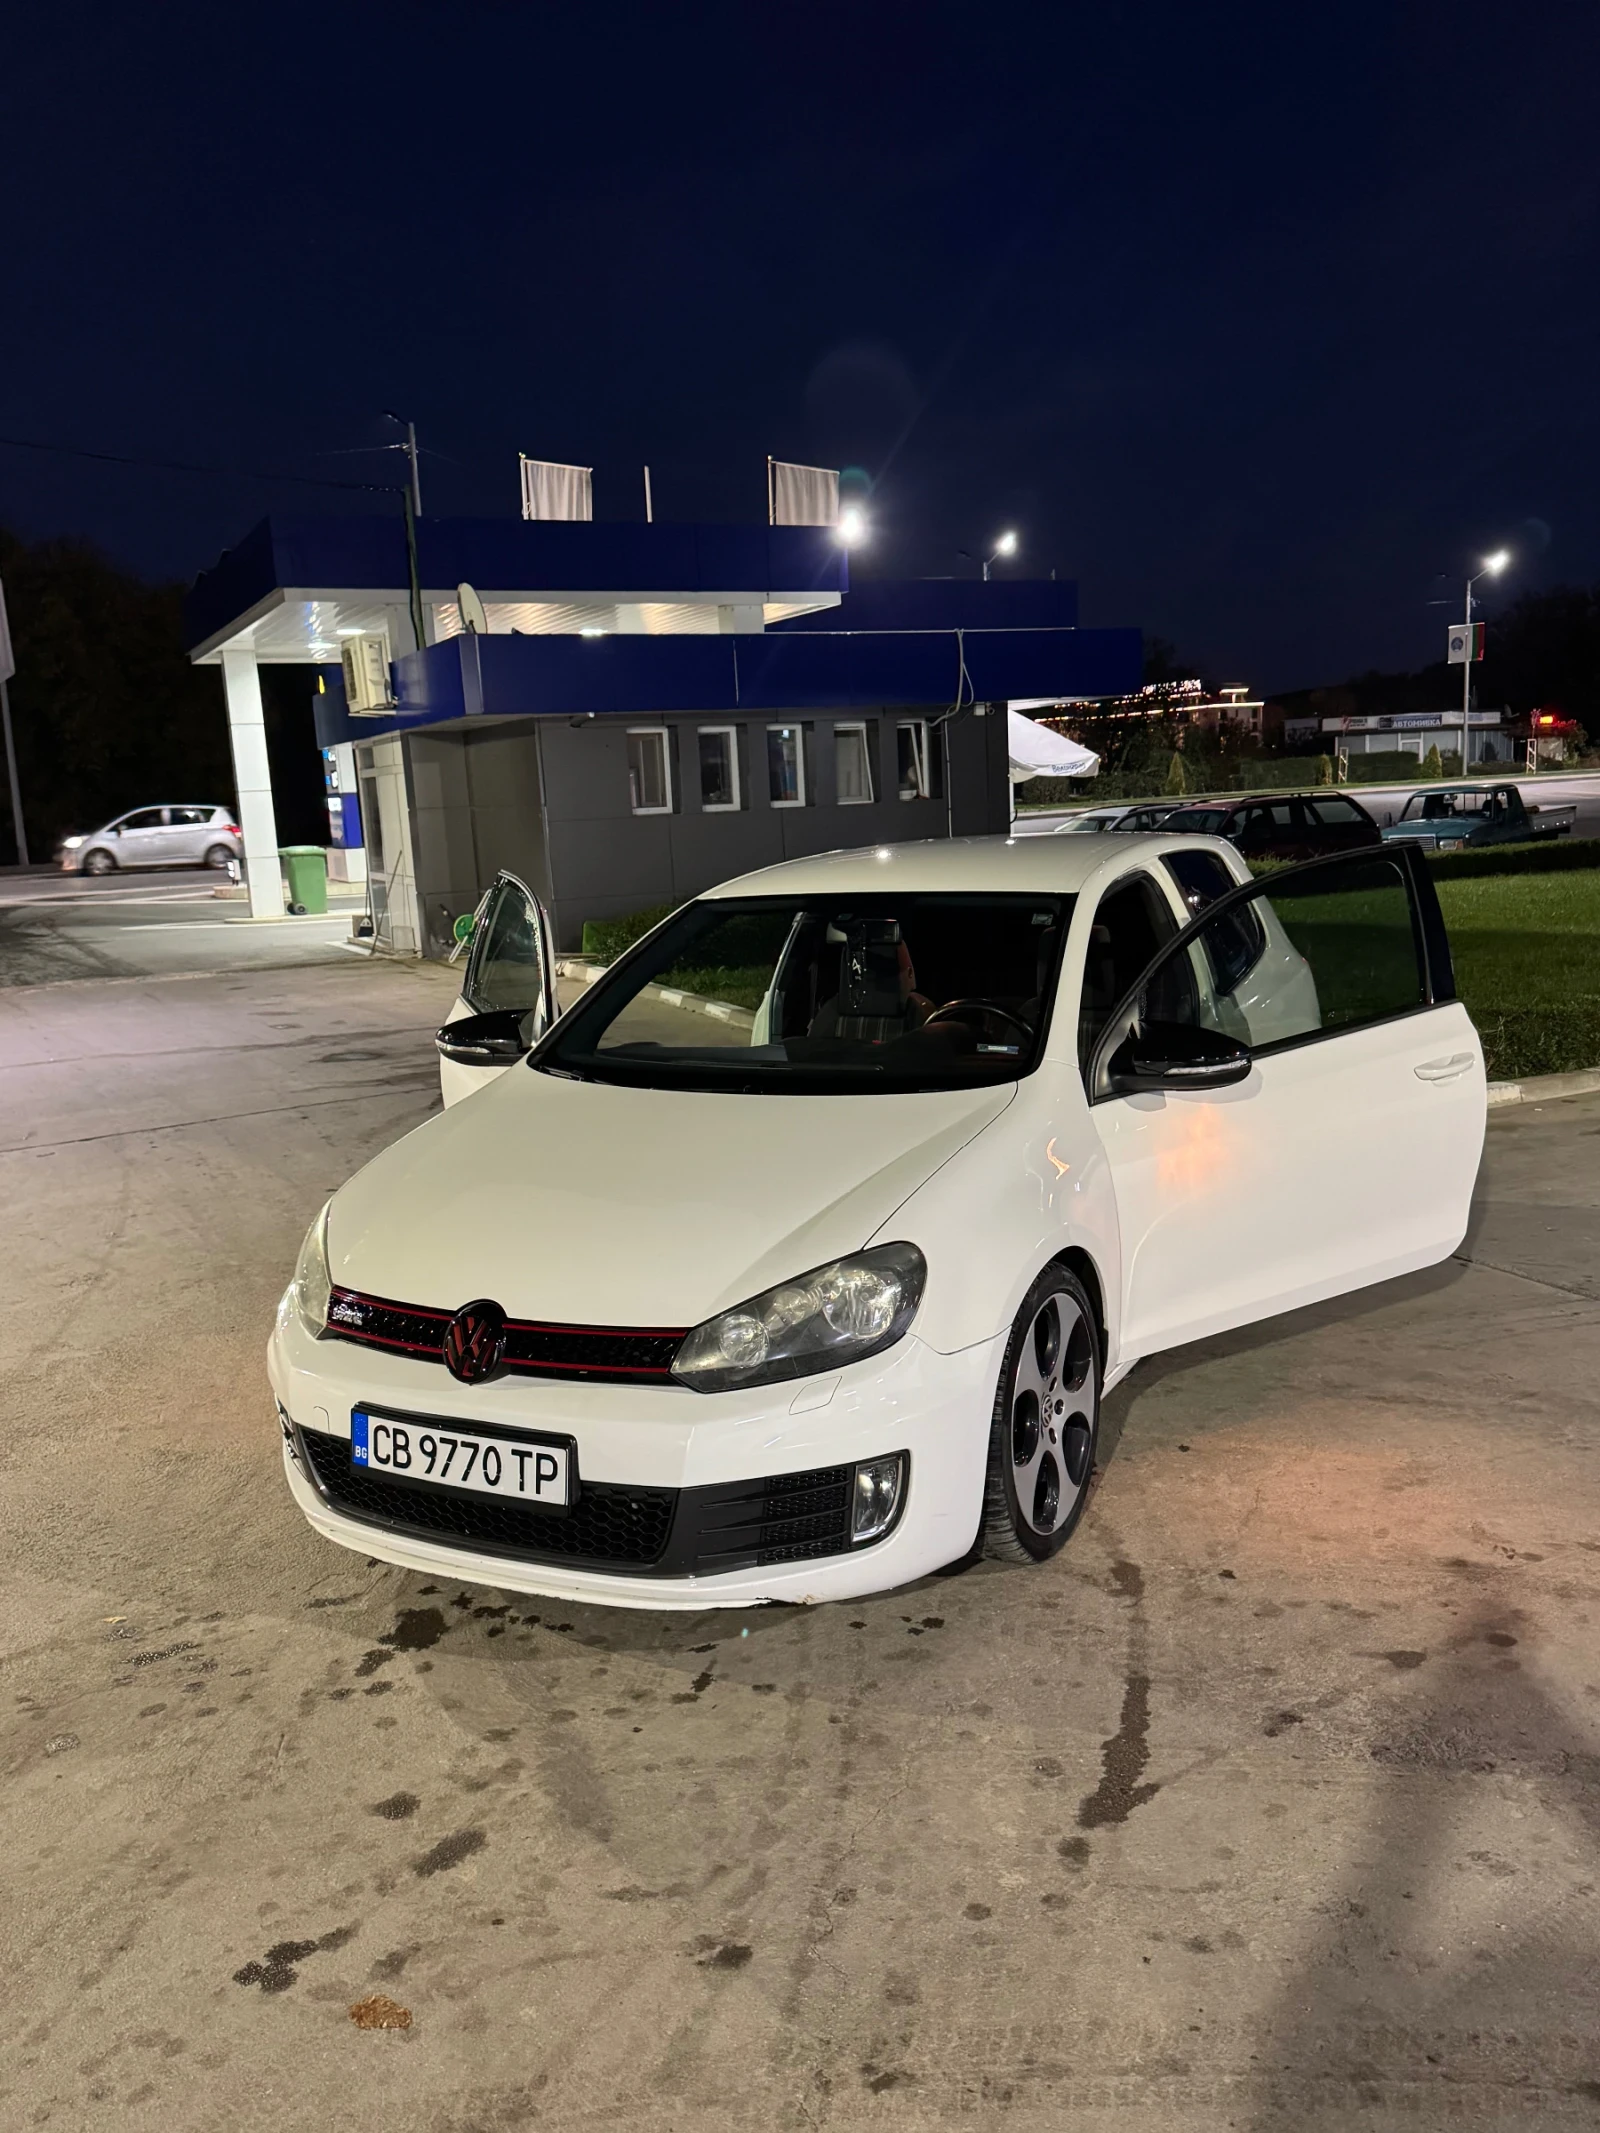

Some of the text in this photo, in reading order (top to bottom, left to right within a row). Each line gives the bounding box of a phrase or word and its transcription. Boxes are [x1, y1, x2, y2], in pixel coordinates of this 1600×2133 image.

[1393, 719, 1441, 728] АВТОМИВКА
[355, 1445, 367, 1459] BG
[373, 1425, 558, 1494] CB 9770 TP
